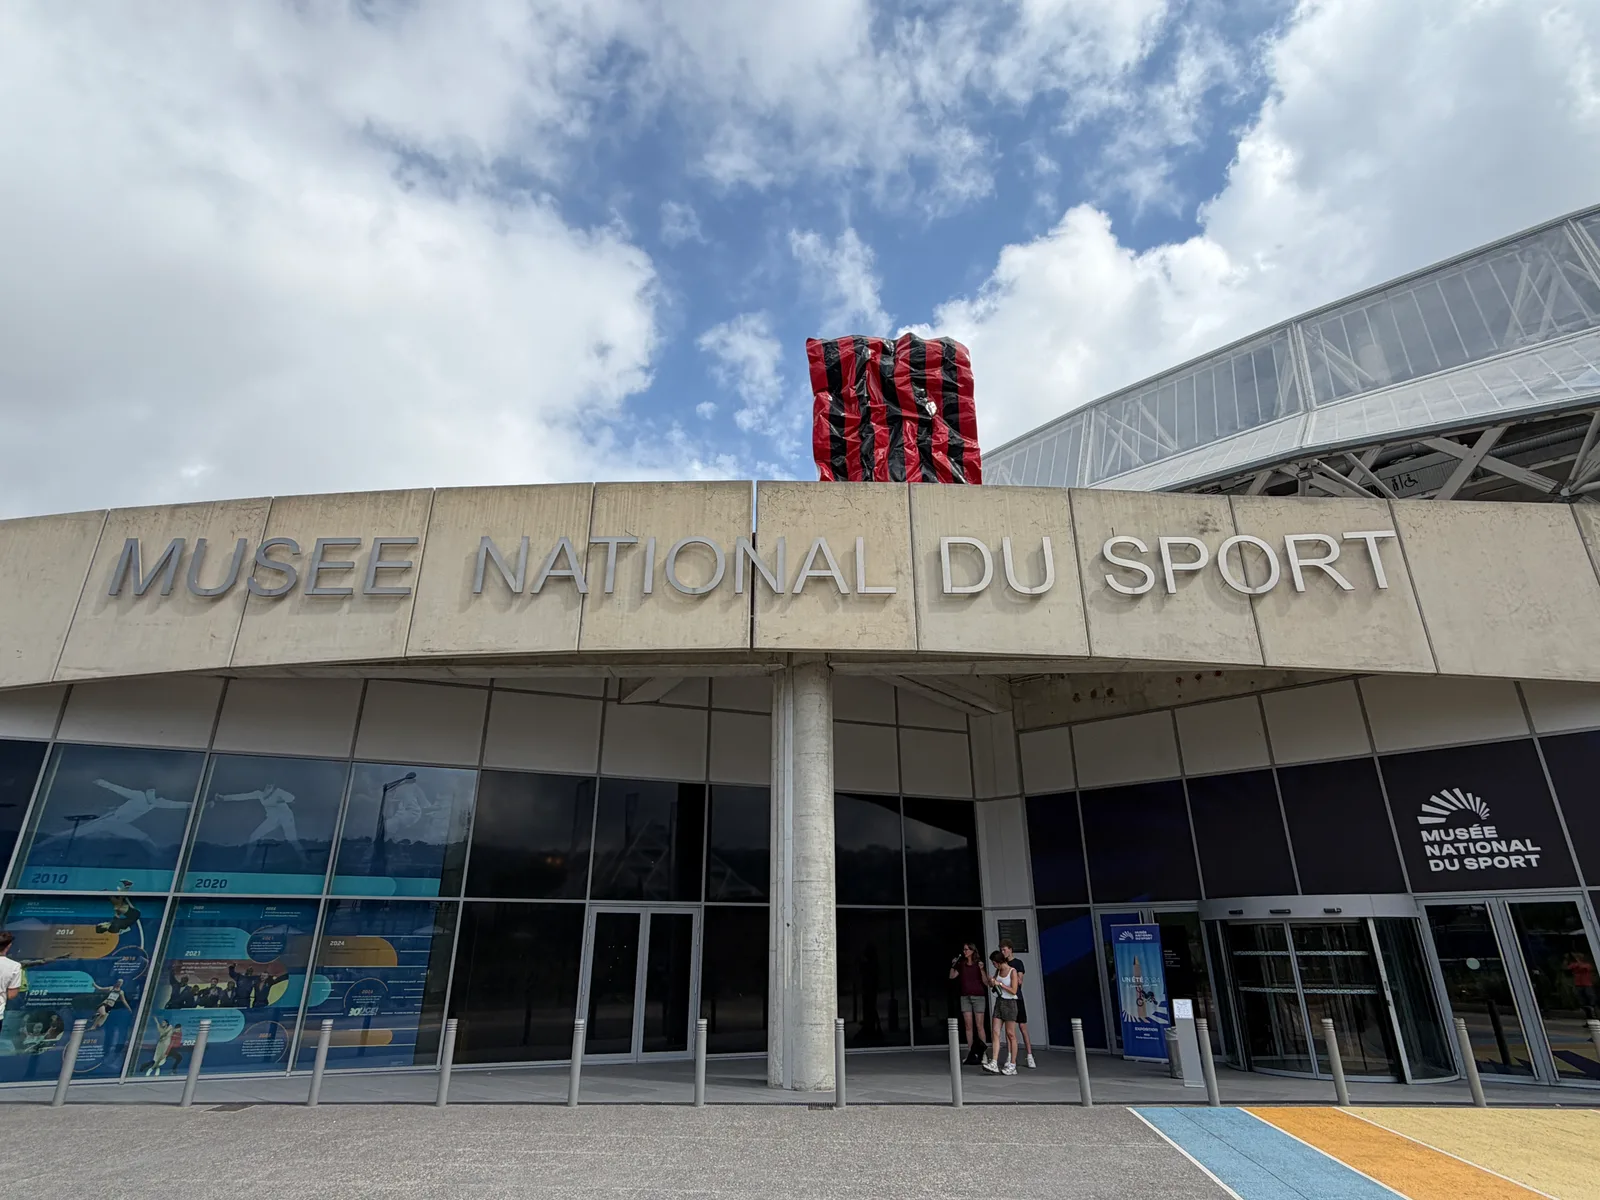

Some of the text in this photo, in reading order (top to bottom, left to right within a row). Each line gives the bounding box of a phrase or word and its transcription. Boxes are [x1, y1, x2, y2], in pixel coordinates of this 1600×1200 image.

[108, 529, 1396, 598] MUSEE NATIONAL DU SPORT
[1420, 824, 1498, 842] MUSÉE
[1424, 838, 1542, 857] NATIONAL
[1428, 854, 1541, 871] DU SPORT
[31, 873, 69, 884] 2010
[195, 878, 228, 889] 2020
